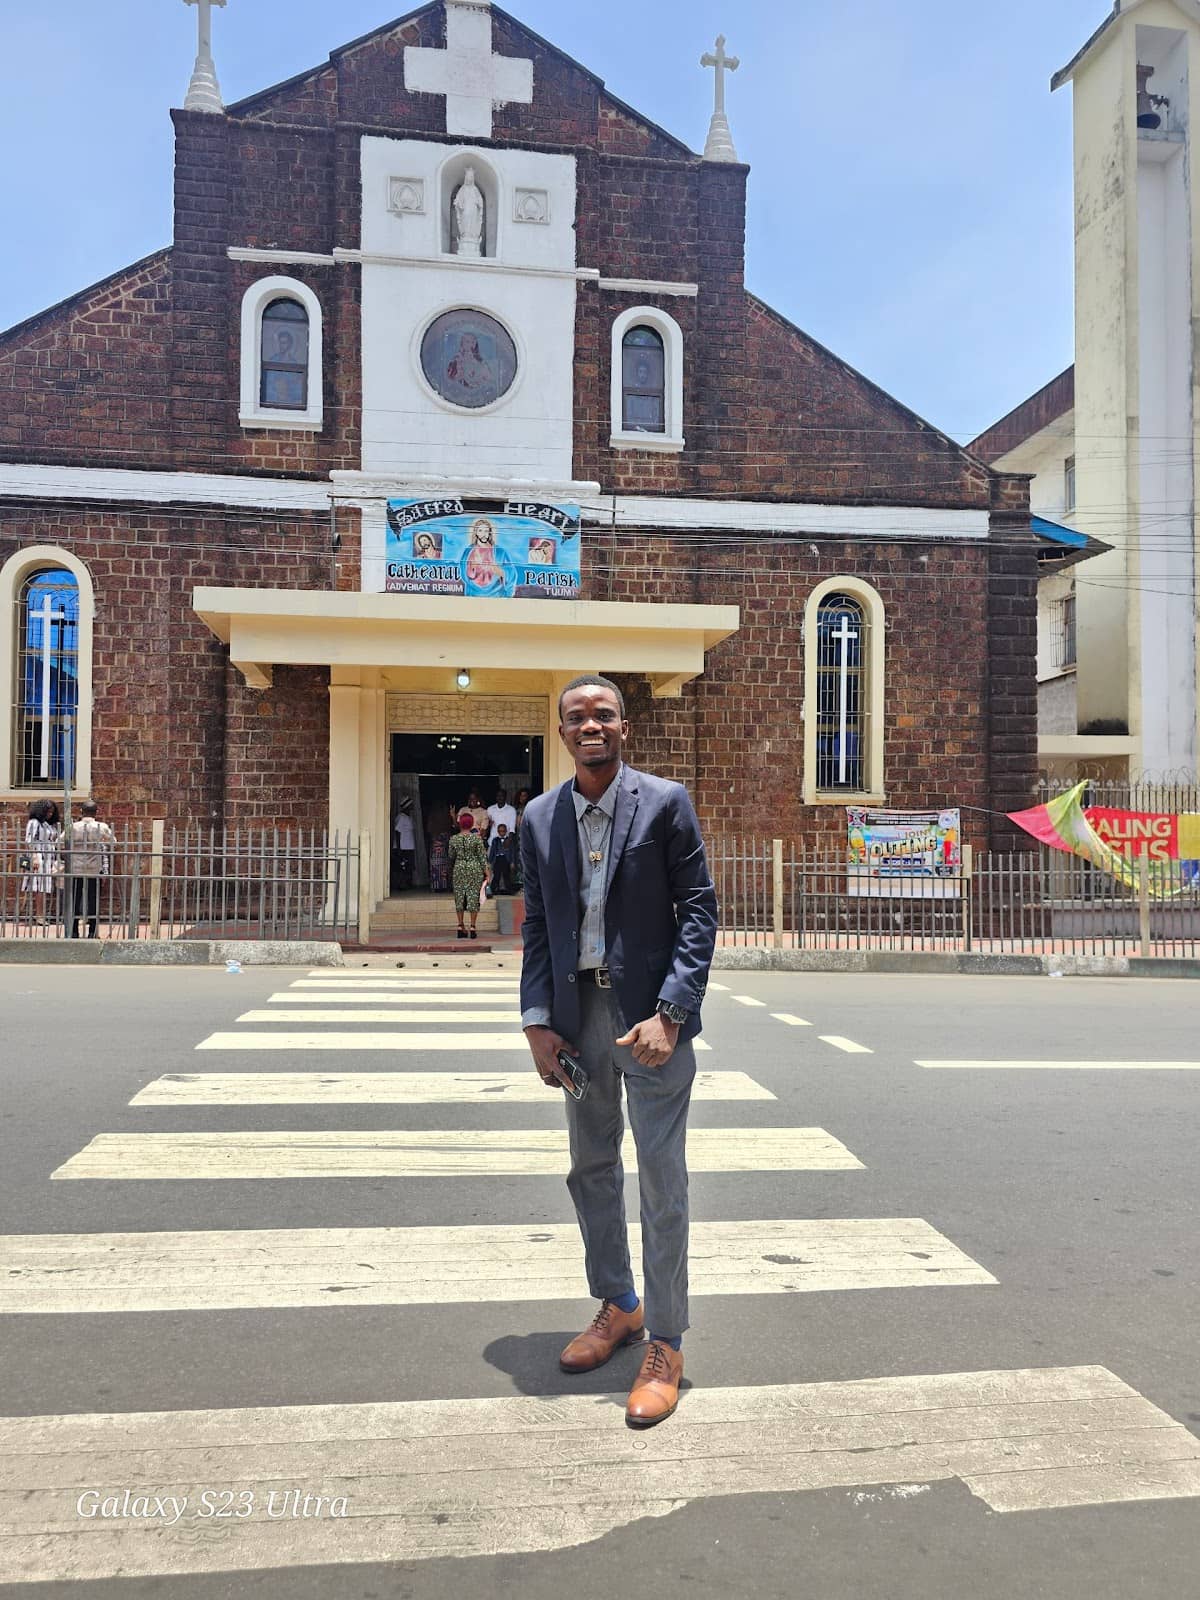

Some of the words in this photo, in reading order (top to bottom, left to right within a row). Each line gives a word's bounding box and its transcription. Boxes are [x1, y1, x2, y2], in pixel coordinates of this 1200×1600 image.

[396, 499, 464, 527] Sacred
[503, 503, 569, 530] Heart
[387, 563, 462, 581] Cathedral
[525, 570, 577, 588] Parish
